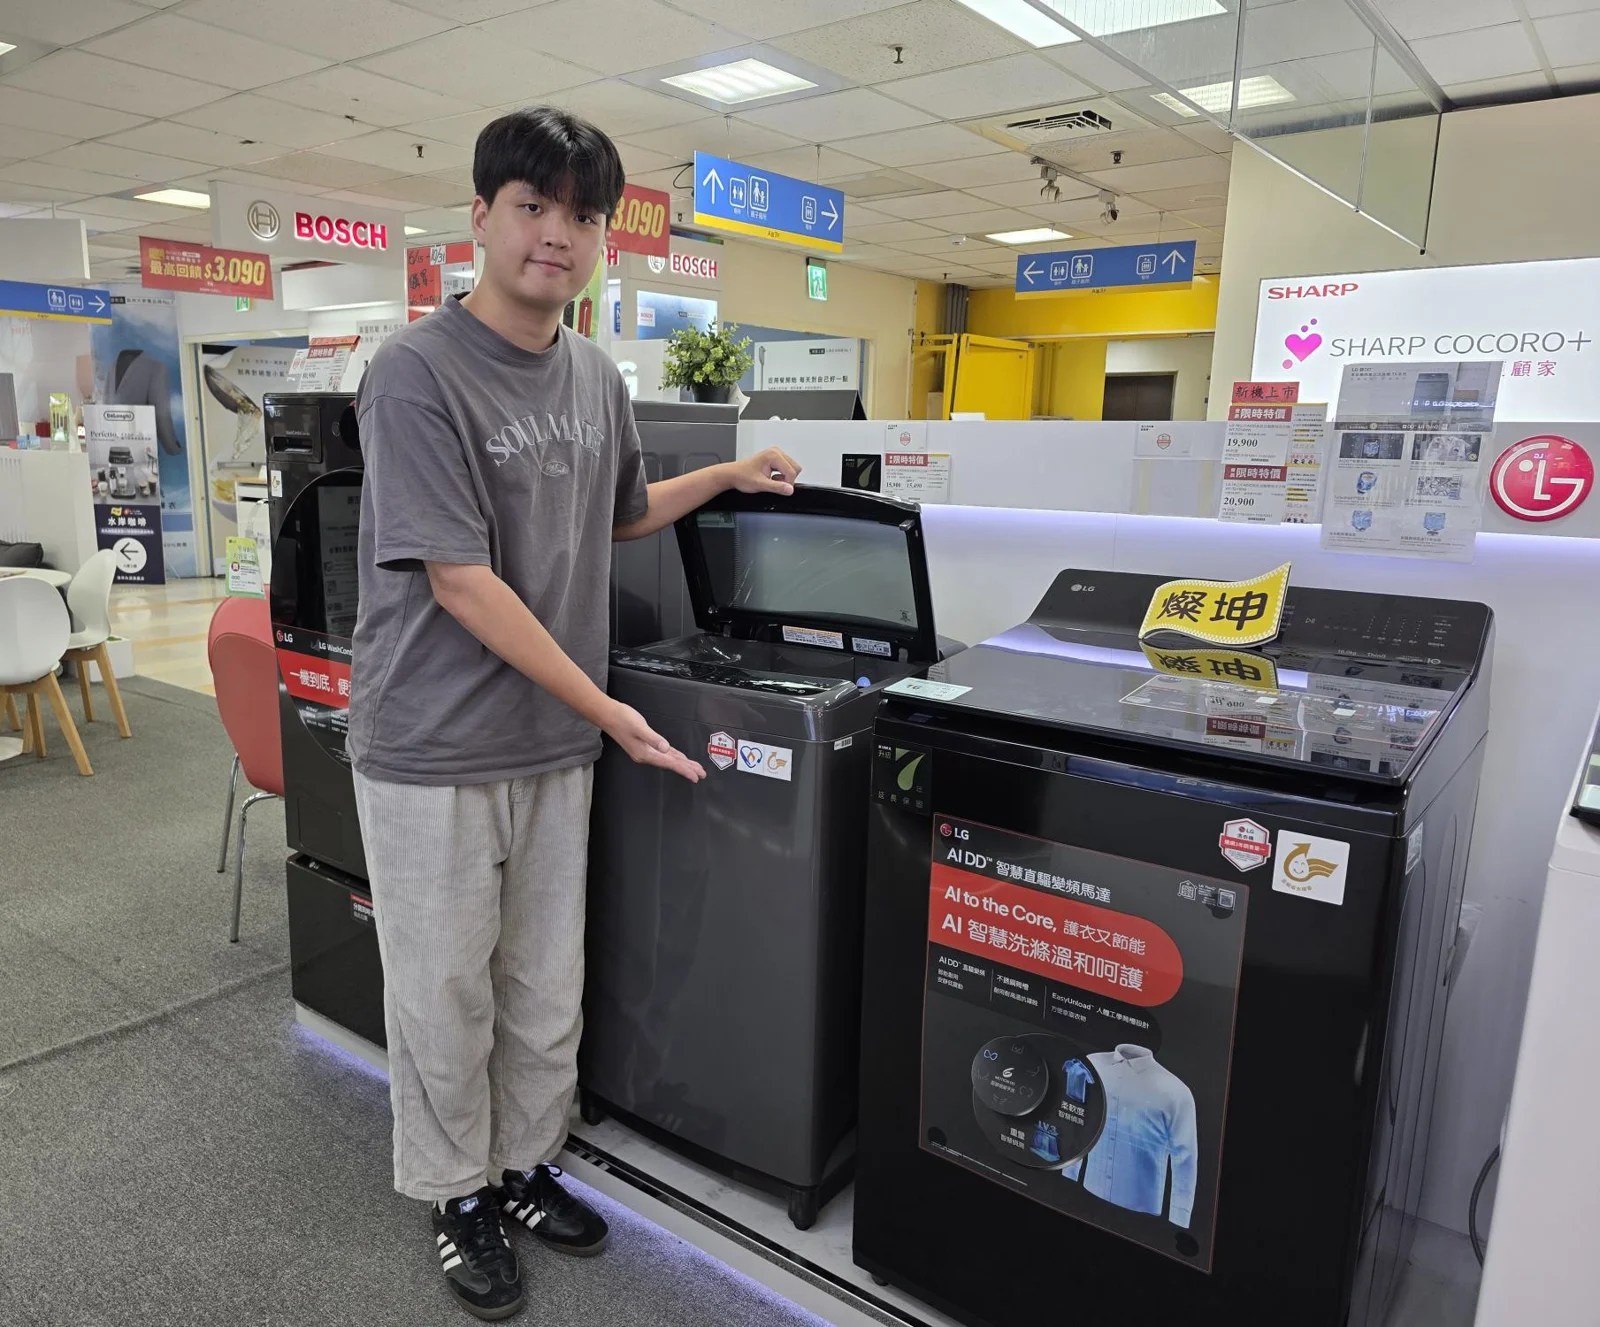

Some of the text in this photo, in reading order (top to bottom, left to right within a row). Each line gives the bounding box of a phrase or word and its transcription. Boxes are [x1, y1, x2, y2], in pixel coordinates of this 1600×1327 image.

[294, 212, 387, 249] BOSCH
[204, 256, 266, 286] $3,090
[671, 253, 717, 278] BOSCH
[1268, 283, 1359, 300] SHARP
[1330, 330, 1592, 357] SHARP COCORO+
[1501, 360, 1557, 377] 顧家
[1235, 386, 1296, 400] 新機上市
[1240, 408, 1286, 420] 限時特價
[1227, 437, 1258, 447] 19,900
[1223, 497, 1255, 507] 20,900
[1156, 590, 1269, 631] 燦坤
[284, 633, 293, 642] LG
[289, 668, 352, 698] 一機到底，便
[954, 827, 970, 840] LG
[947, 848, 962, 863] AI
[996, 860, 1111, 904] 智慧直驅變頻馬達
[944, 885, 1146, 956] AI to the Core, 護衣又節能
[941, 913, 1144, 992] AI 智慧洗滌溫和呵護
